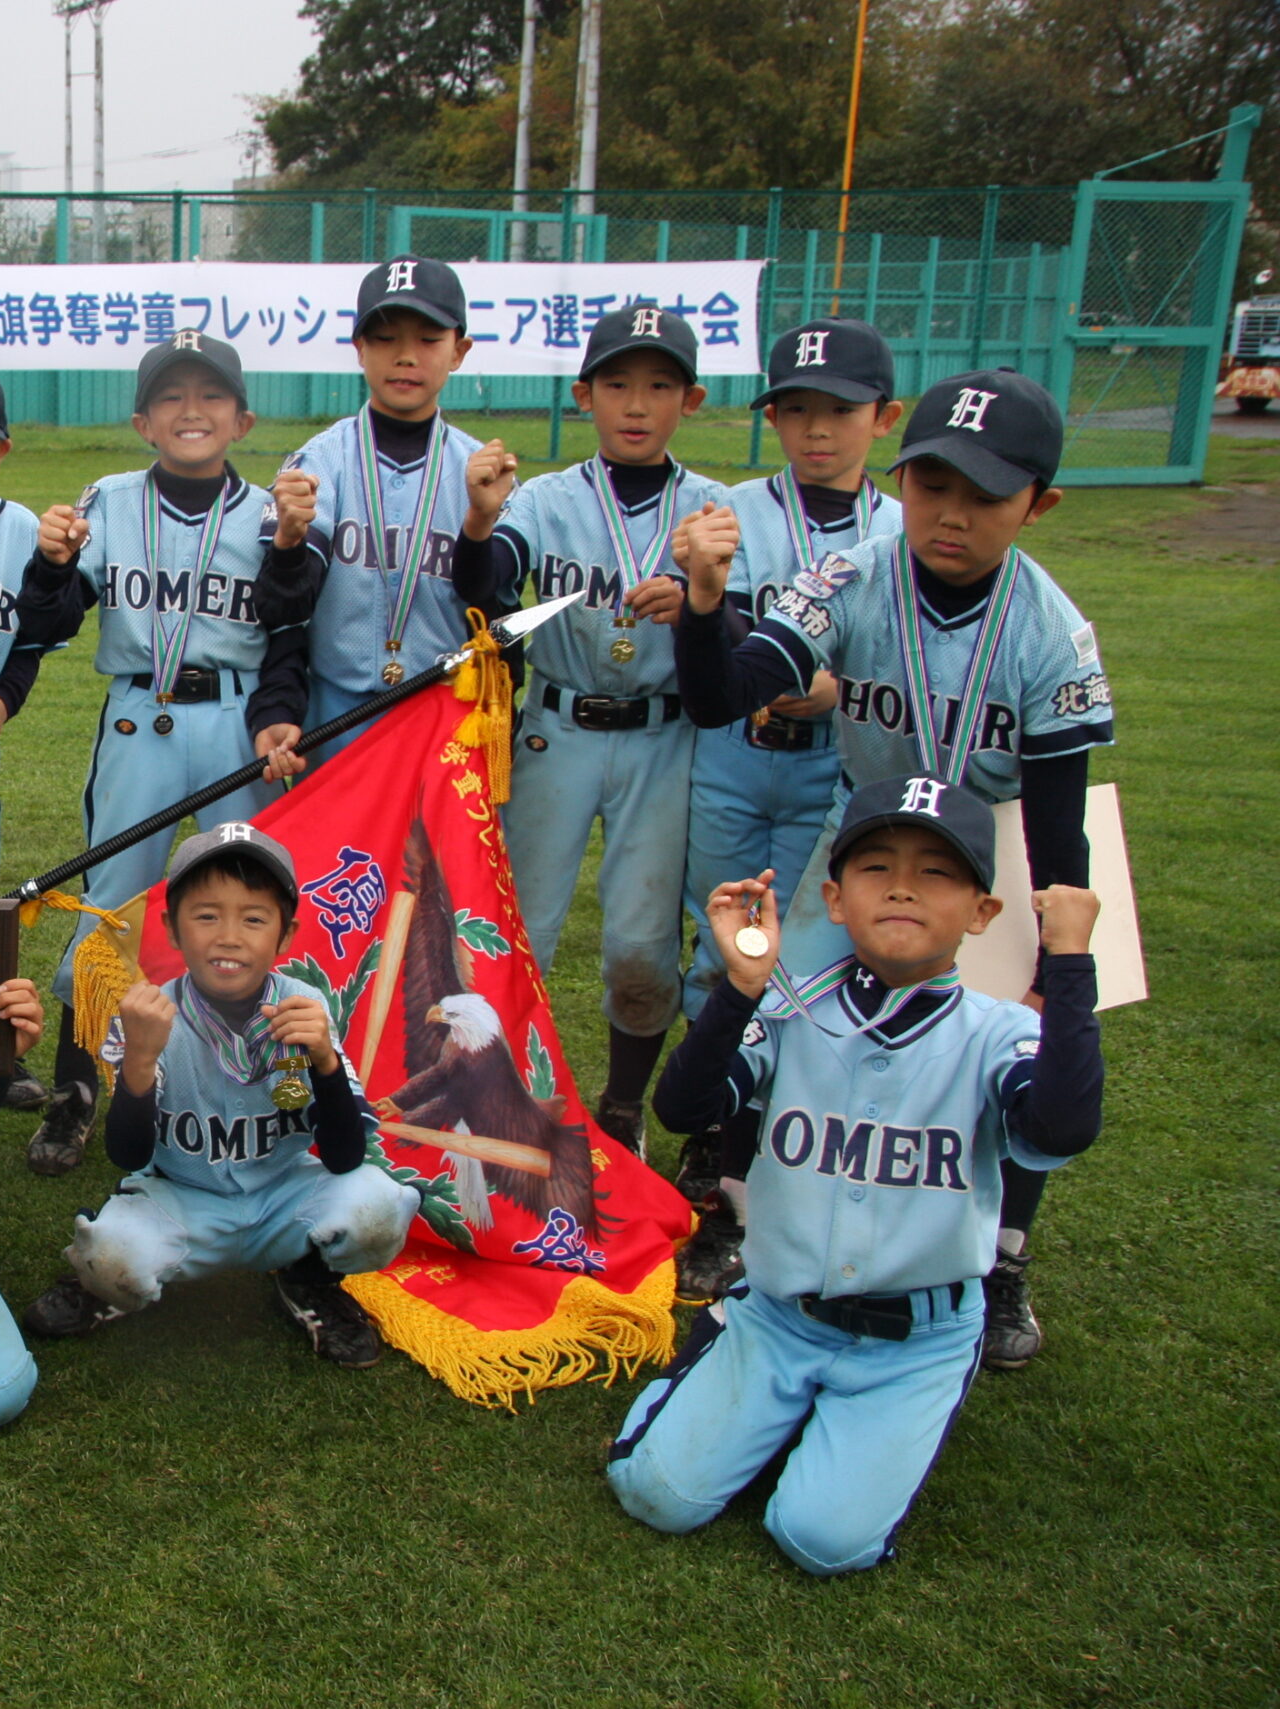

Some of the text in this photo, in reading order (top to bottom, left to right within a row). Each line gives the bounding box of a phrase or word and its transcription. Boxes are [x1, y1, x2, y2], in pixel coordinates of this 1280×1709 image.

[386, 260, 418, 293] H
[172, 331, 202, 354] H
[630, 308, 662, 337] H
[795, 331, 830, 368] H
[946, 388, 998, 432] H
[333, 517, 458, 582] OMR
[540, 553, 689, 612] HOM
[898, 777, 947, 818] H
[770, 1106, 972, 1193] OMER
